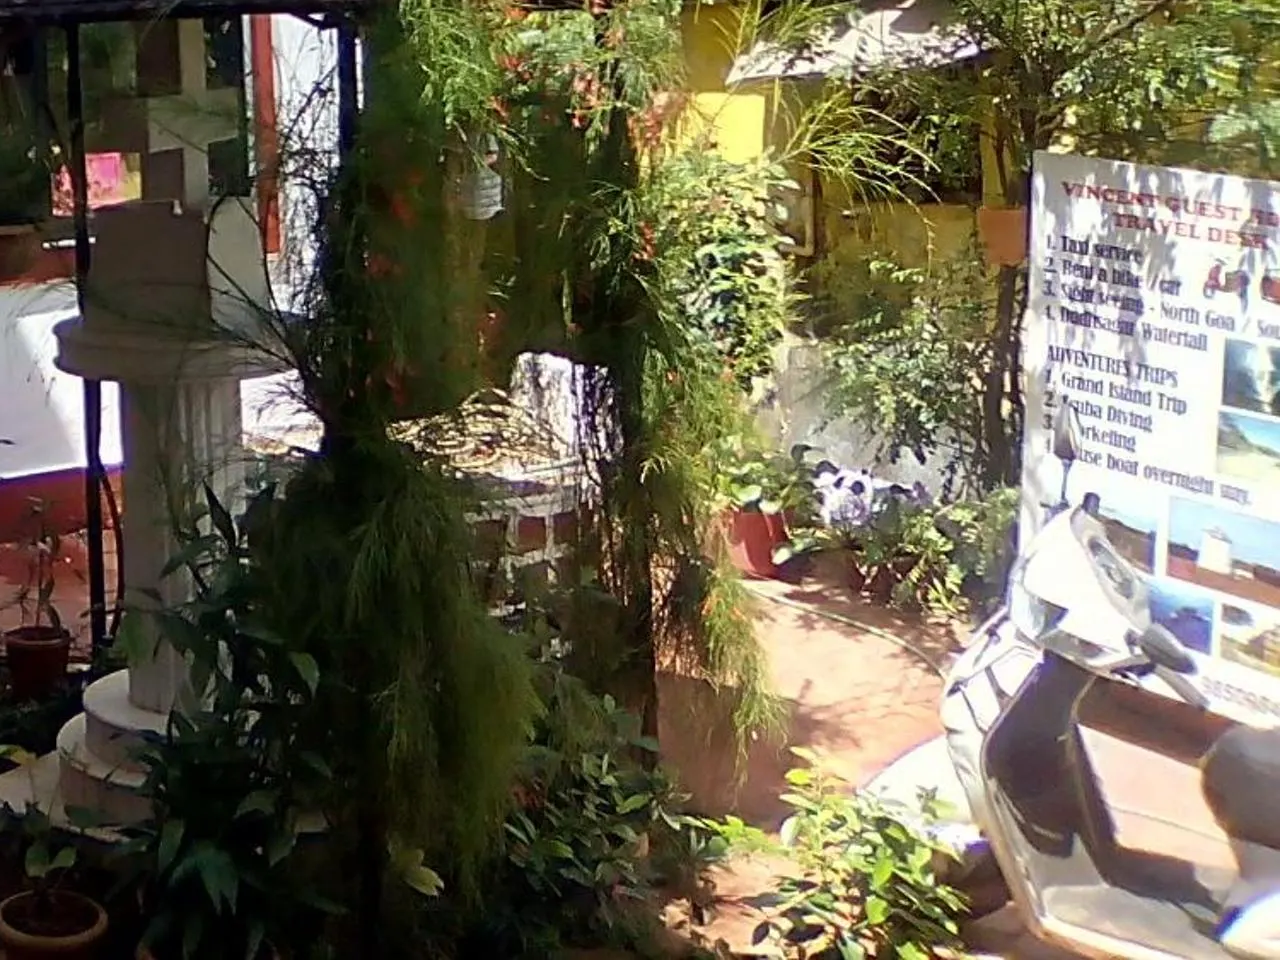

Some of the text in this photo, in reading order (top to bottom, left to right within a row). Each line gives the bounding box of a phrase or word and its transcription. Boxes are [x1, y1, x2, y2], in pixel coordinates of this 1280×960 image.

[1061, 182, 1160, 207] VINCENT
[1165, 196, 1242, 220] GUEST
[1061, 236, 1089, 256] Taxi
[1095, 243, 1143, 264] service
[1113, 212, 1268, 251] TRAVEL DESK
[1062, 259, 1093, 280] Rent
[1098, 269, 1108, 282] a
[1160, 280, 1182, 296] car
[1160, 301, 1200, 326] North
[1206, 310, 1235, 331] Goa
[1141, 322, 1208, 351] Waterfall
[1047, 345, 1178, 388] ADVENTURES TRIPS
[1061, 371, 1104, 396] Grand
[1109, 382, 1152, 407] Island
[1157, 392, 1187, 415] Trip
[1107, 407, 1153, 432] Diving
[1107, 454, 1139, 476] boat
[1144, 465, 1214, 495] overnight
